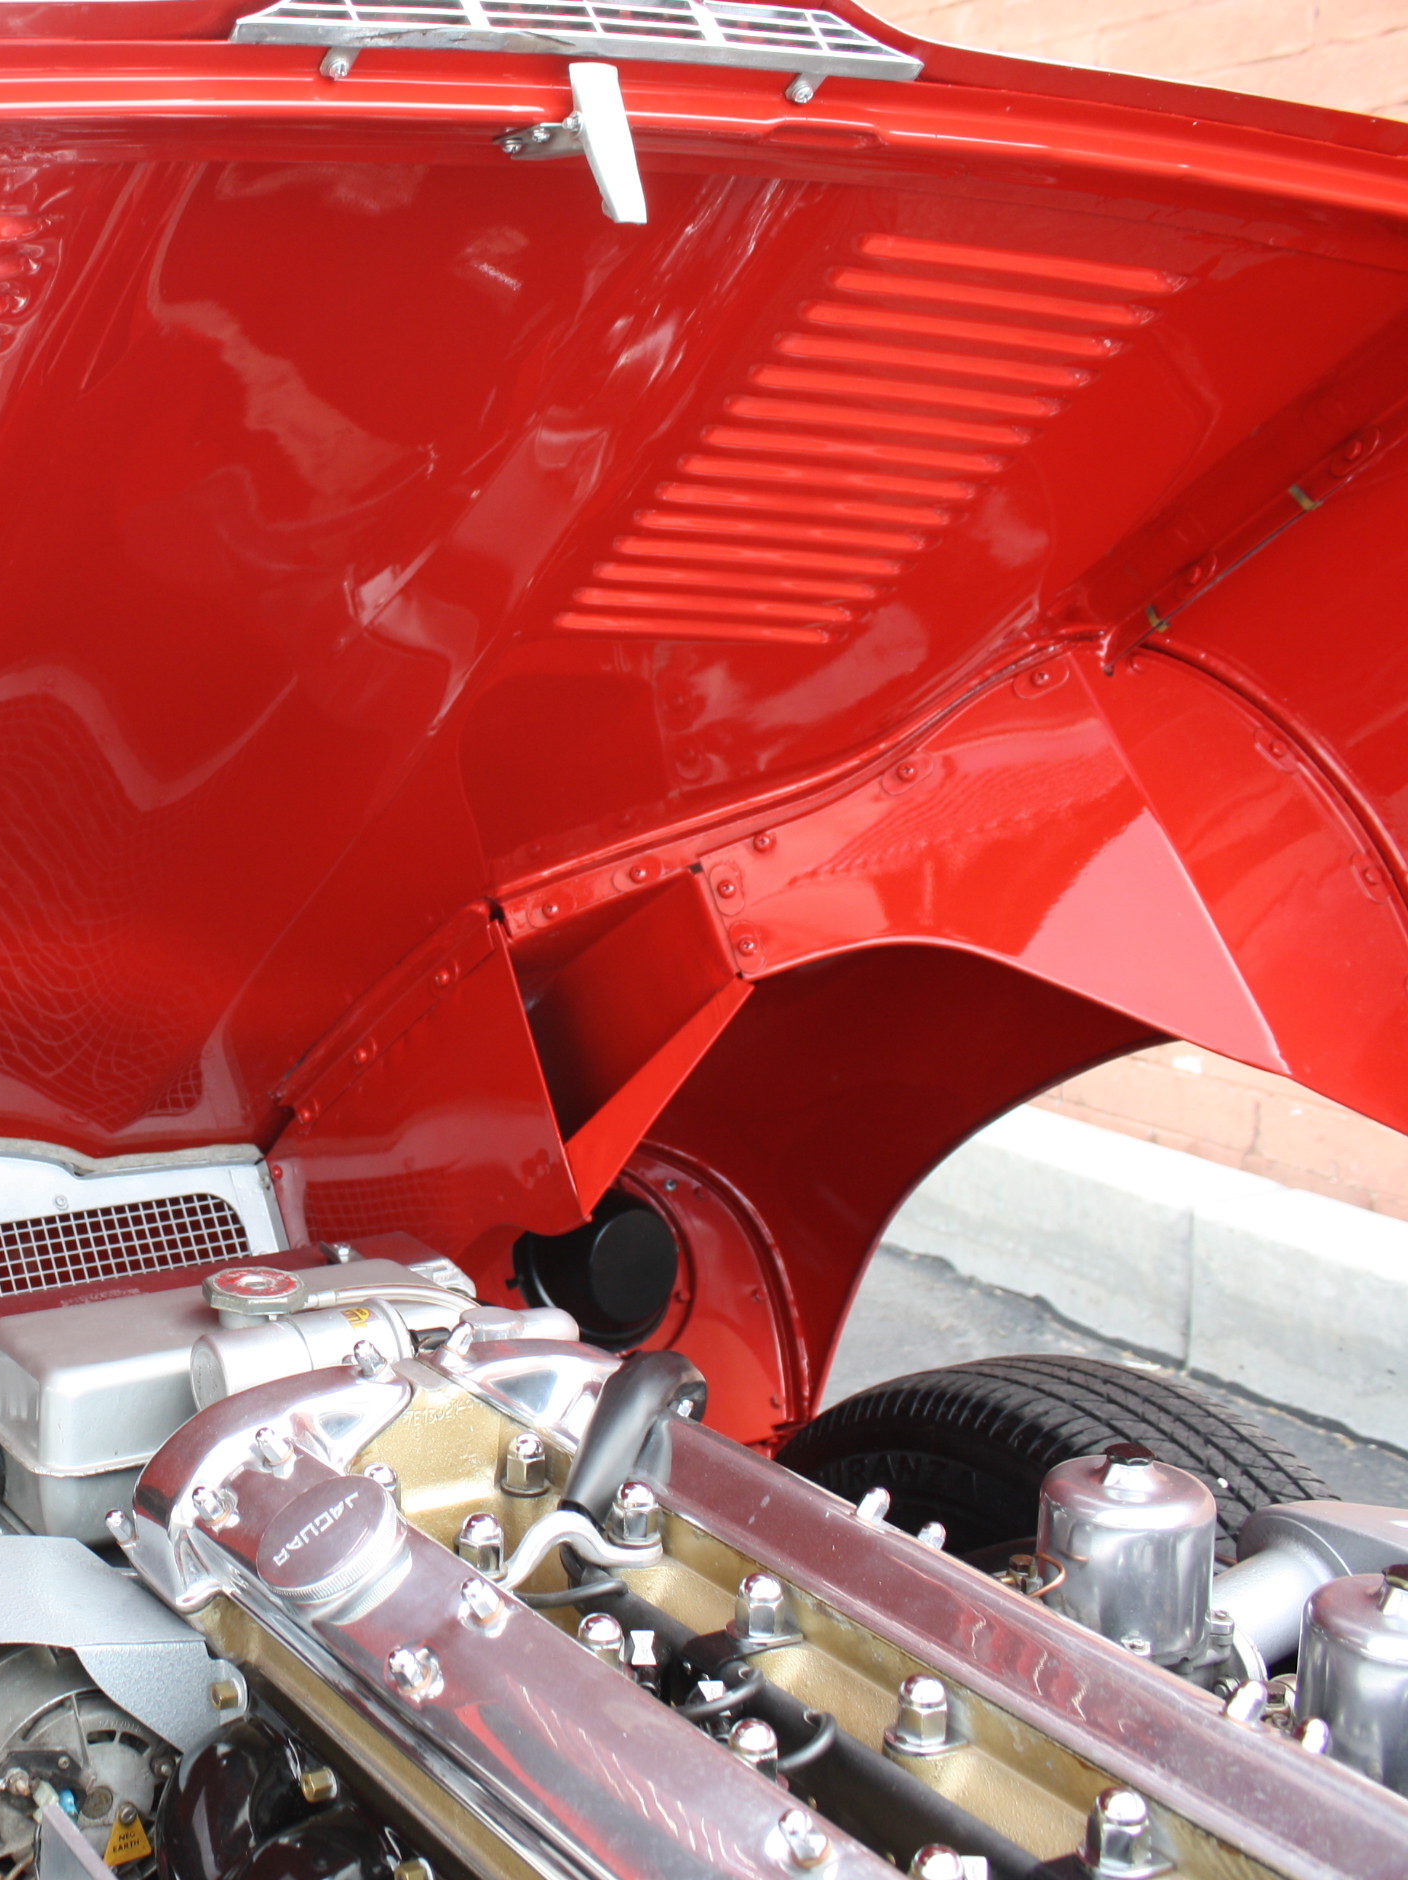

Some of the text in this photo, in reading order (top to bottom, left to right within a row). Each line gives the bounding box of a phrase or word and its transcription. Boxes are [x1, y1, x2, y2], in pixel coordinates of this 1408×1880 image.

[273, 1492, 360, 1567] JAGUAR
[118, 1831, 135, 1842] NEG
[112, 1838, 140, 1853] EARTH
